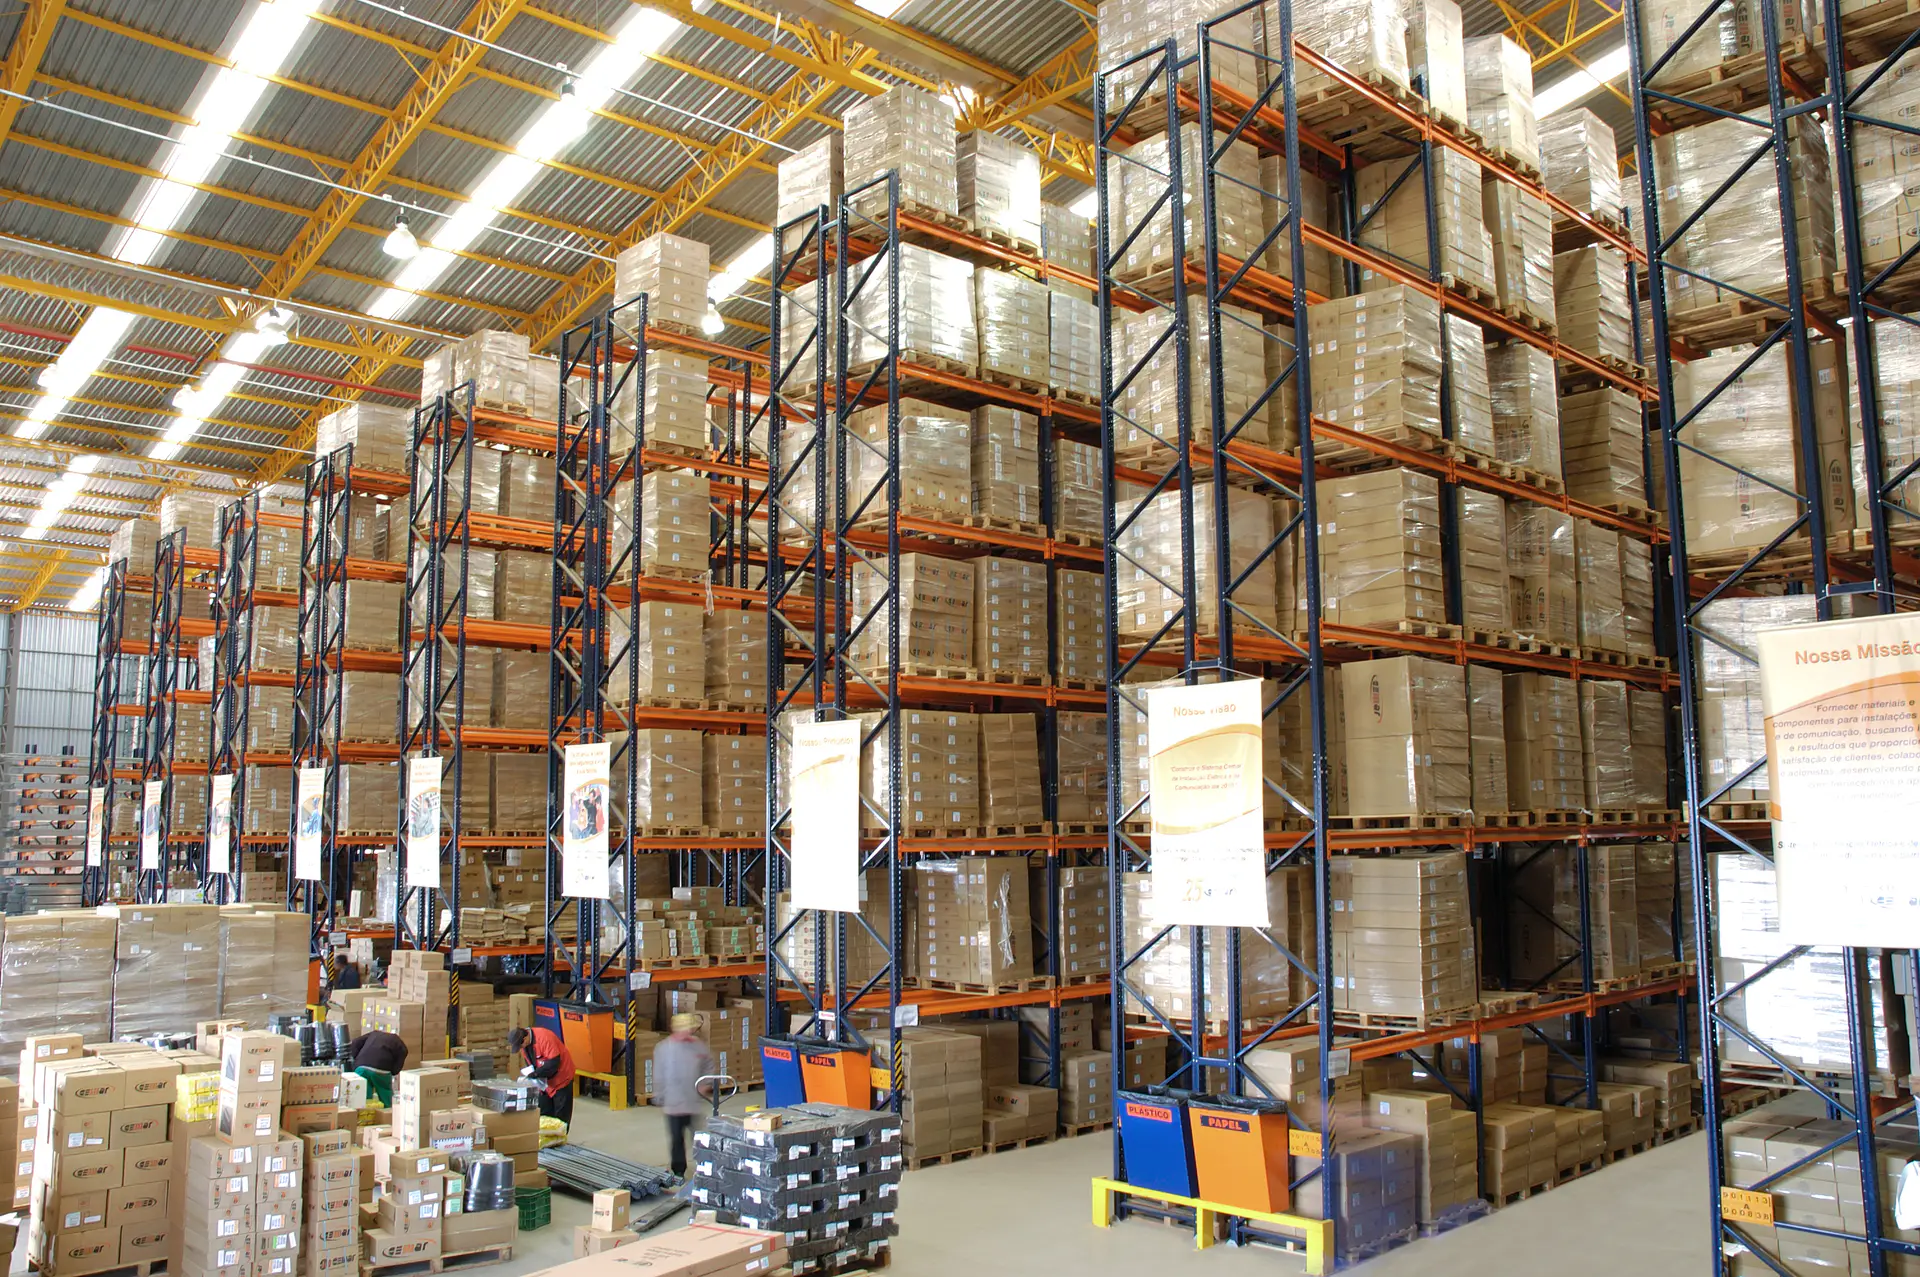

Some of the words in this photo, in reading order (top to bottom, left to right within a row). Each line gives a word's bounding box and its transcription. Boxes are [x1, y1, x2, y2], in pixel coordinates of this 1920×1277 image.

[1831, 466, 1844, 513] cemar
[1795, 649, 1852, 665] Nossa
[1857, 641, 1920, 659] Missão
[1372, 680, 1381, 716] cemar
[1861, 699, 1906, 709] materiais
[1772, 717, 1835, 728] componentes
[1837, 716, 1858, 726] para
[1861, 711, 1918, 722] instalações
[1783, 731, 1794, 740] de
[1797, 728, 1862, 739] comunicação,
[1865, 725, 1914, 735] buscando
[1797, 742, 1846, 752] resultados
[1849, 741, 1867, 750] que
[1869, 738, 1920, 749] proporcio
[1782, 756, 1827, 766] satisfação
[1830, 753, 1842, 762] de
[1845, 752, 1884, 762] clientes,
[809, 1056, 832, 1066] PAPEL
[1208, 1115, 1243, 1131] PAPEL
[139, 1158, 168, 1168] cemar
[388, 1241, 429, 1256] cemar
